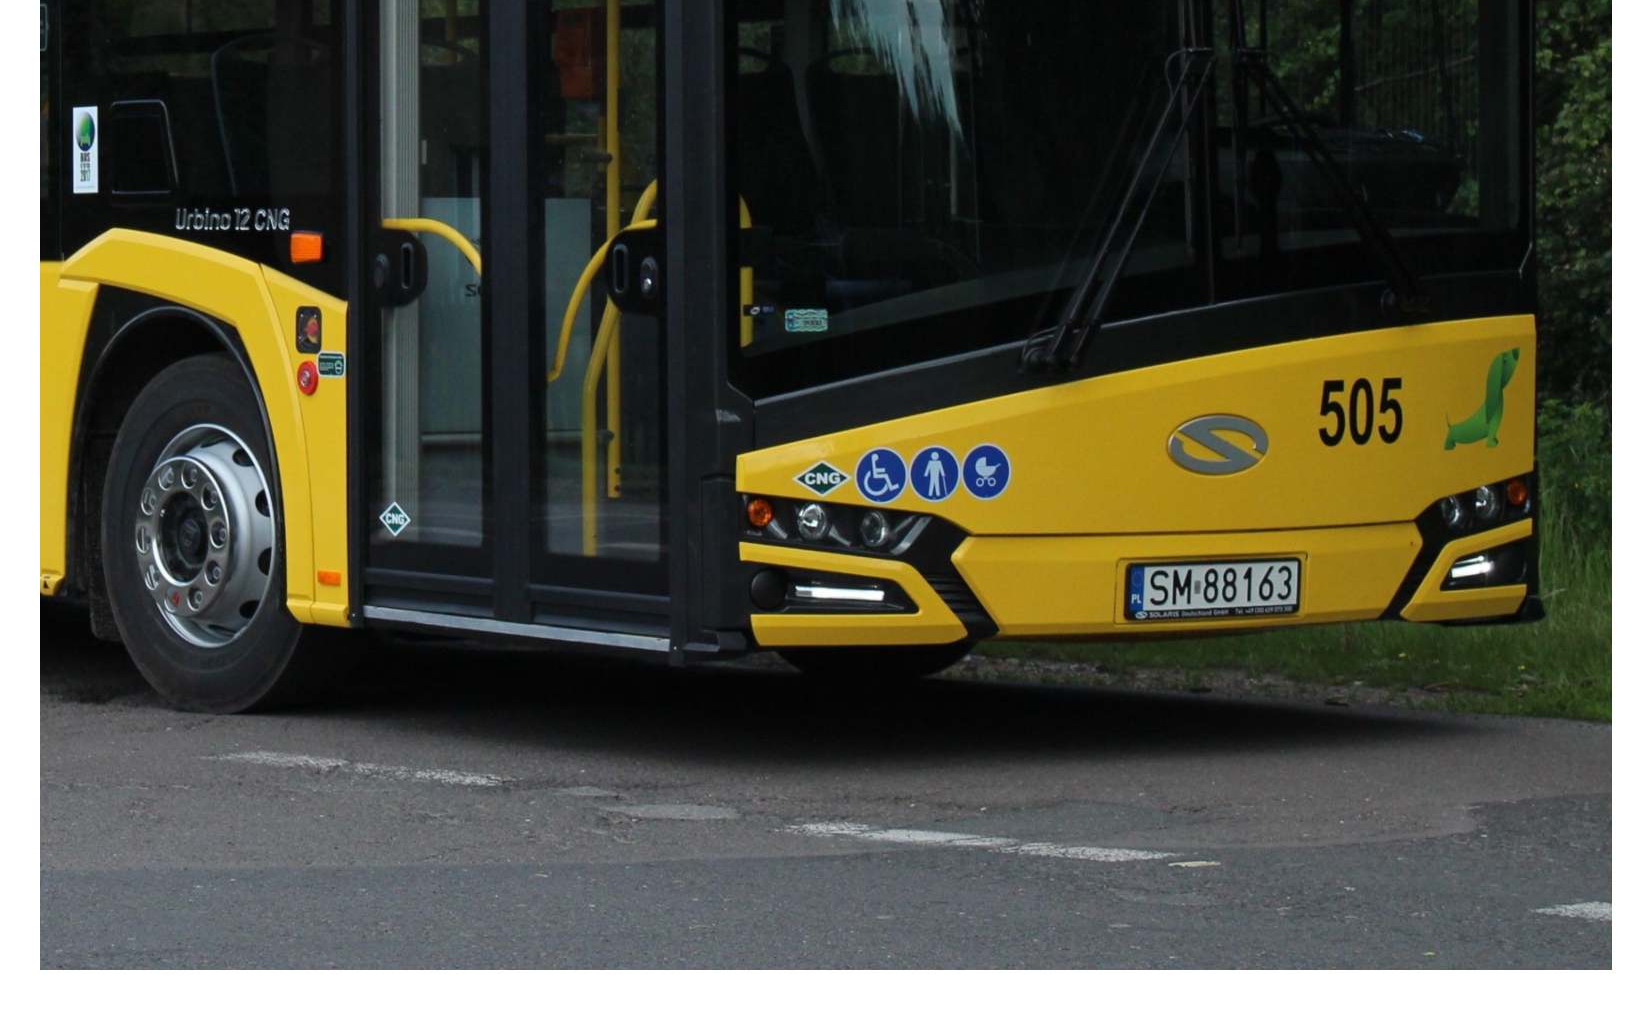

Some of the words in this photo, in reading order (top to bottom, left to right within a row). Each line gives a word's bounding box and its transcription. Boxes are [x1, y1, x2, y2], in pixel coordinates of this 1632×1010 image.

[175, 207, 232, 231] Urbino
[234, 208, 250, 231] 12
[254, 208, 290, 231] CNG
[1318, 377, 1404, 447] 505
[804, 472, 841, 485] CNG
[385, 512, 405, 525] CNG
[1149, 568, 1193, 606] SM
[1203, 565, 1293, 604] 88163
[1131, 593, 1142, 604] PL
